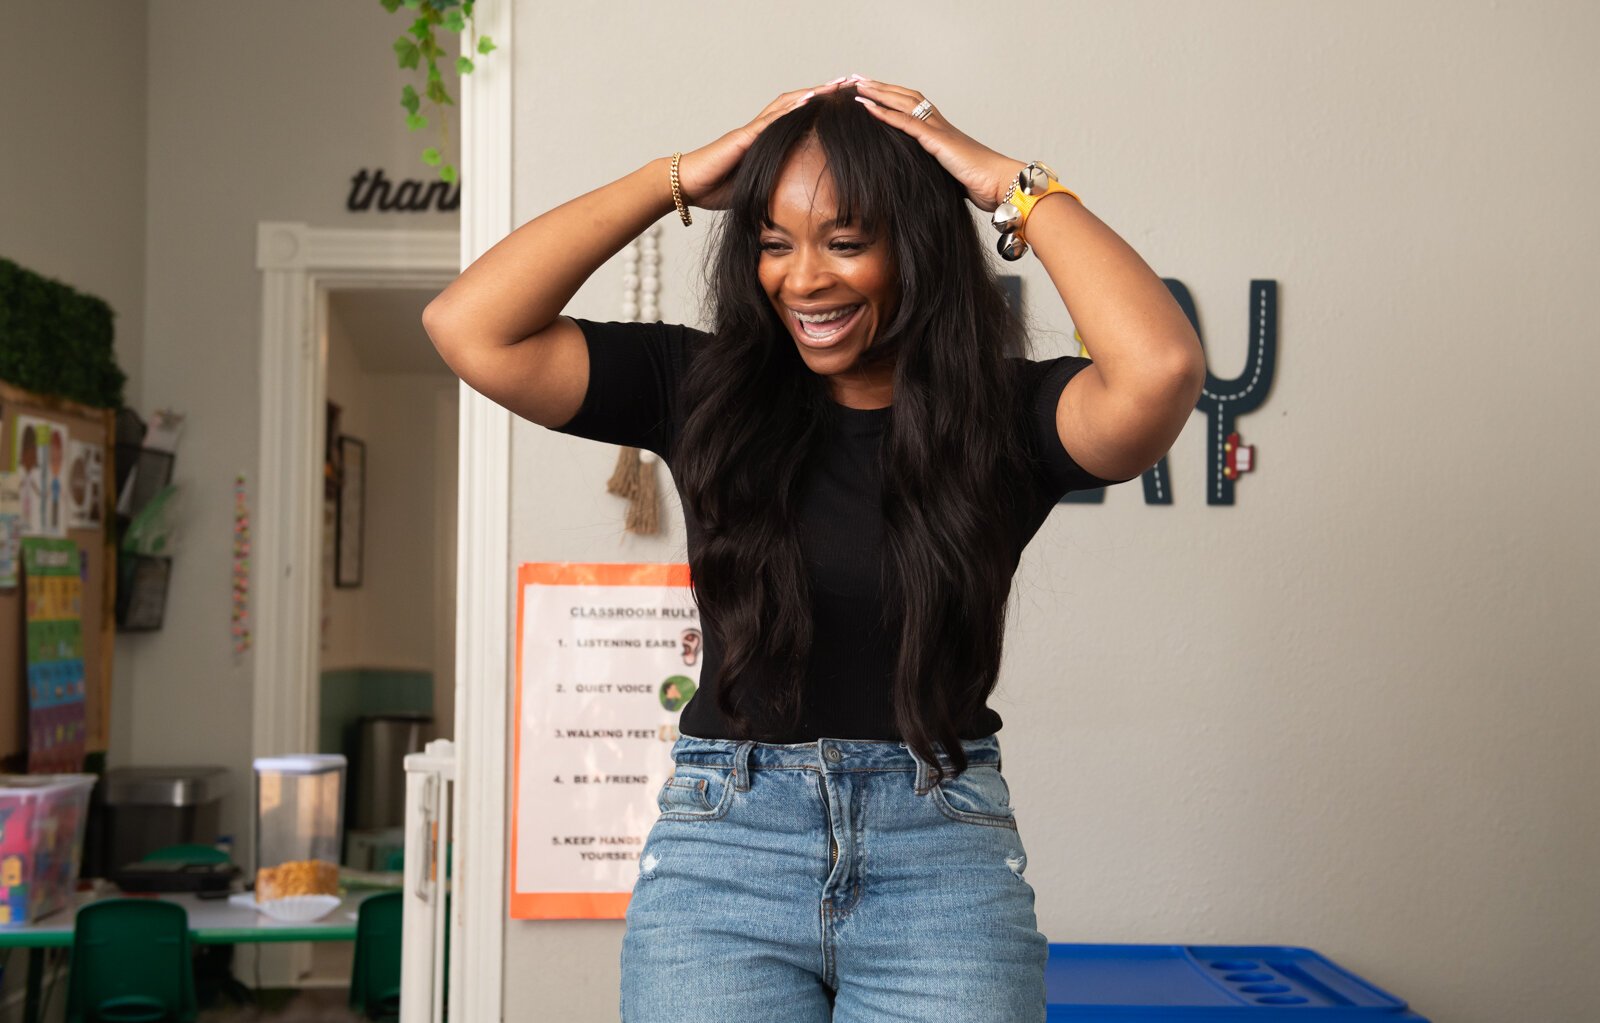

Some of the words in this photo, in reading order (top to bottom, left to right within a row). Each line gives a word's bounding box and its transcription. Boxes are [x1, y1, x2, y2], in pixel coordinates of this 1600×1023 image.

[347, 167, 460, 213] than
[570, 607, 656, 618] CLASSROOM
[661, 607, 697, 618] RULE
[577, 639, 641, 648] LISTENING
[646, 639, 676, 648] EARS
[576, 684, 611, 693] QUIET
[617, 684, 653, 693] VOICE
[566, 729, 623, 738] WALKING
[627, 729, 656, 738] FEET
[574, 775, 589, 784] BE
[594, 775, 601, 784] A
[605, 775, 649, 784] FRIEND
[564, 836, 595, 845] KEEP
[600, 836, 642, 845] HANDS
